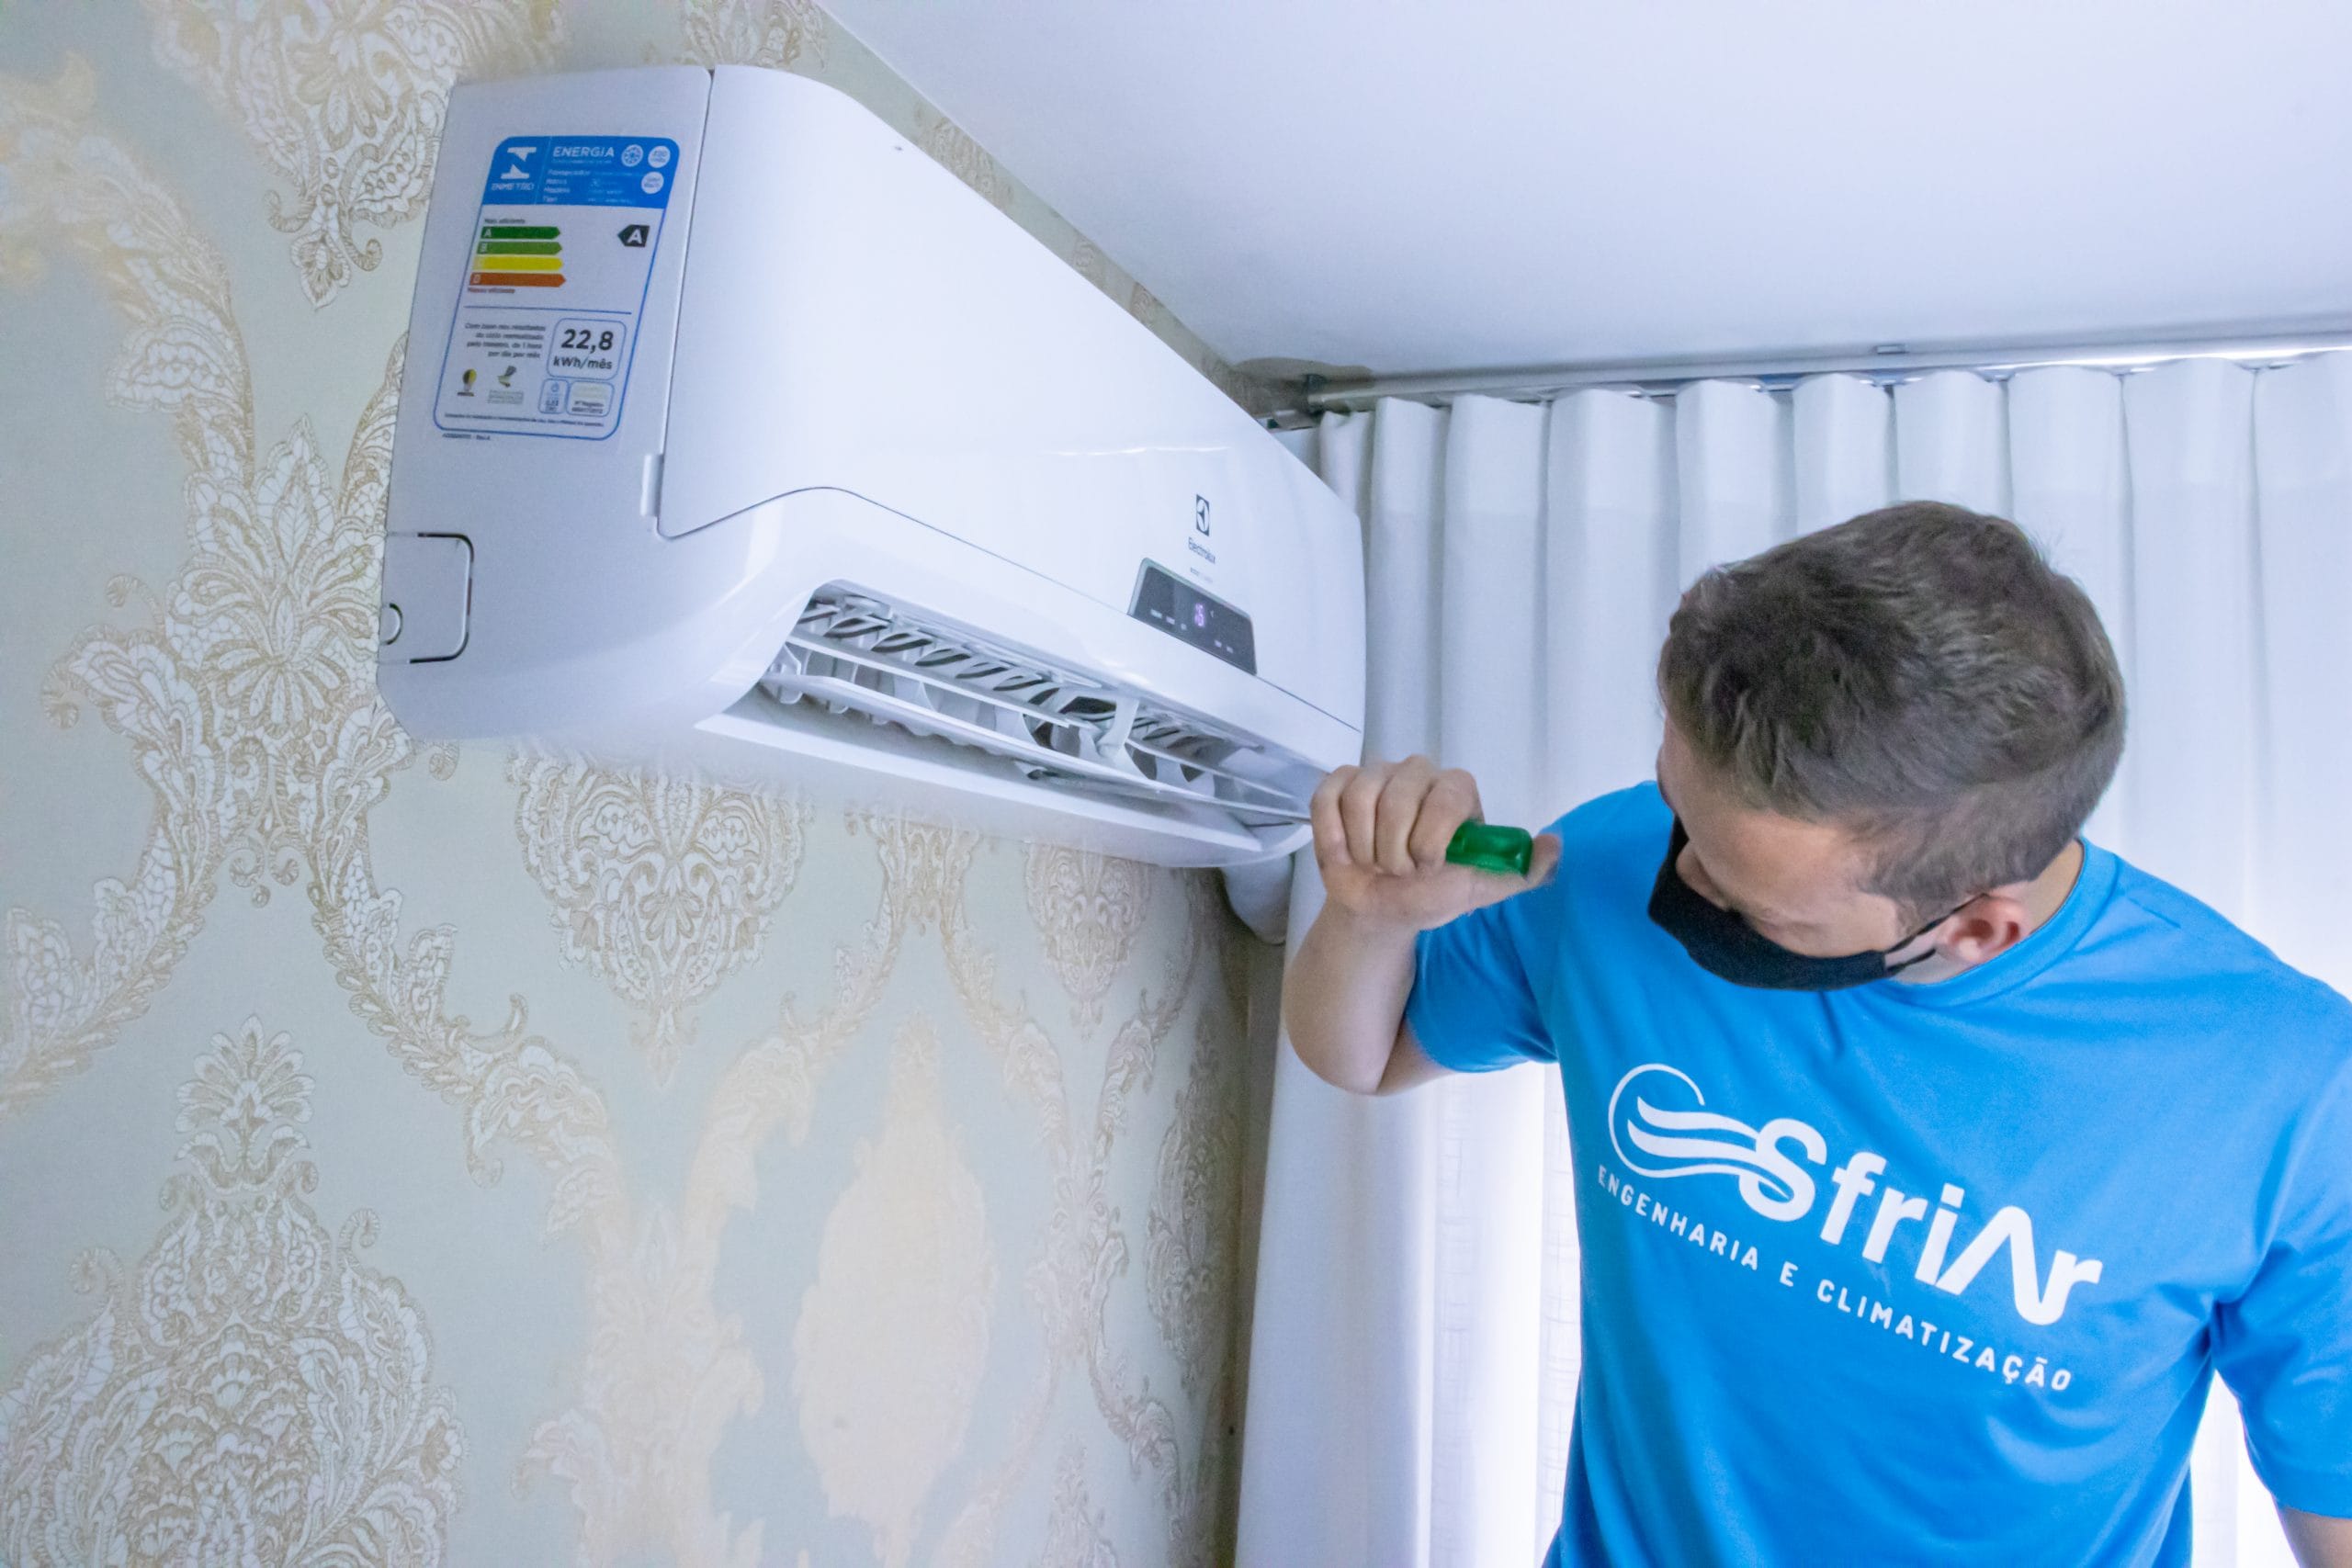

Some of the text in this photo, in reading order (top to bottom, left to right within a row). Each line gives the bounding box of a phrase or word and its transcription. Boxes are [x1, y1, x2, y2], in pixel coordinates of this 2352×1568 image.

[552, 146, 615, 157] ENERGIA
[483, 228, 492, 237] A
[627, 229, 643, 244] A
[560, 329, 614, 354] 22,8
[553, 355, 613, 369] kWh/mês
[1597, 1165, 2073, 1393] ENGENHARIA E CLIMATIZAÇÃO
